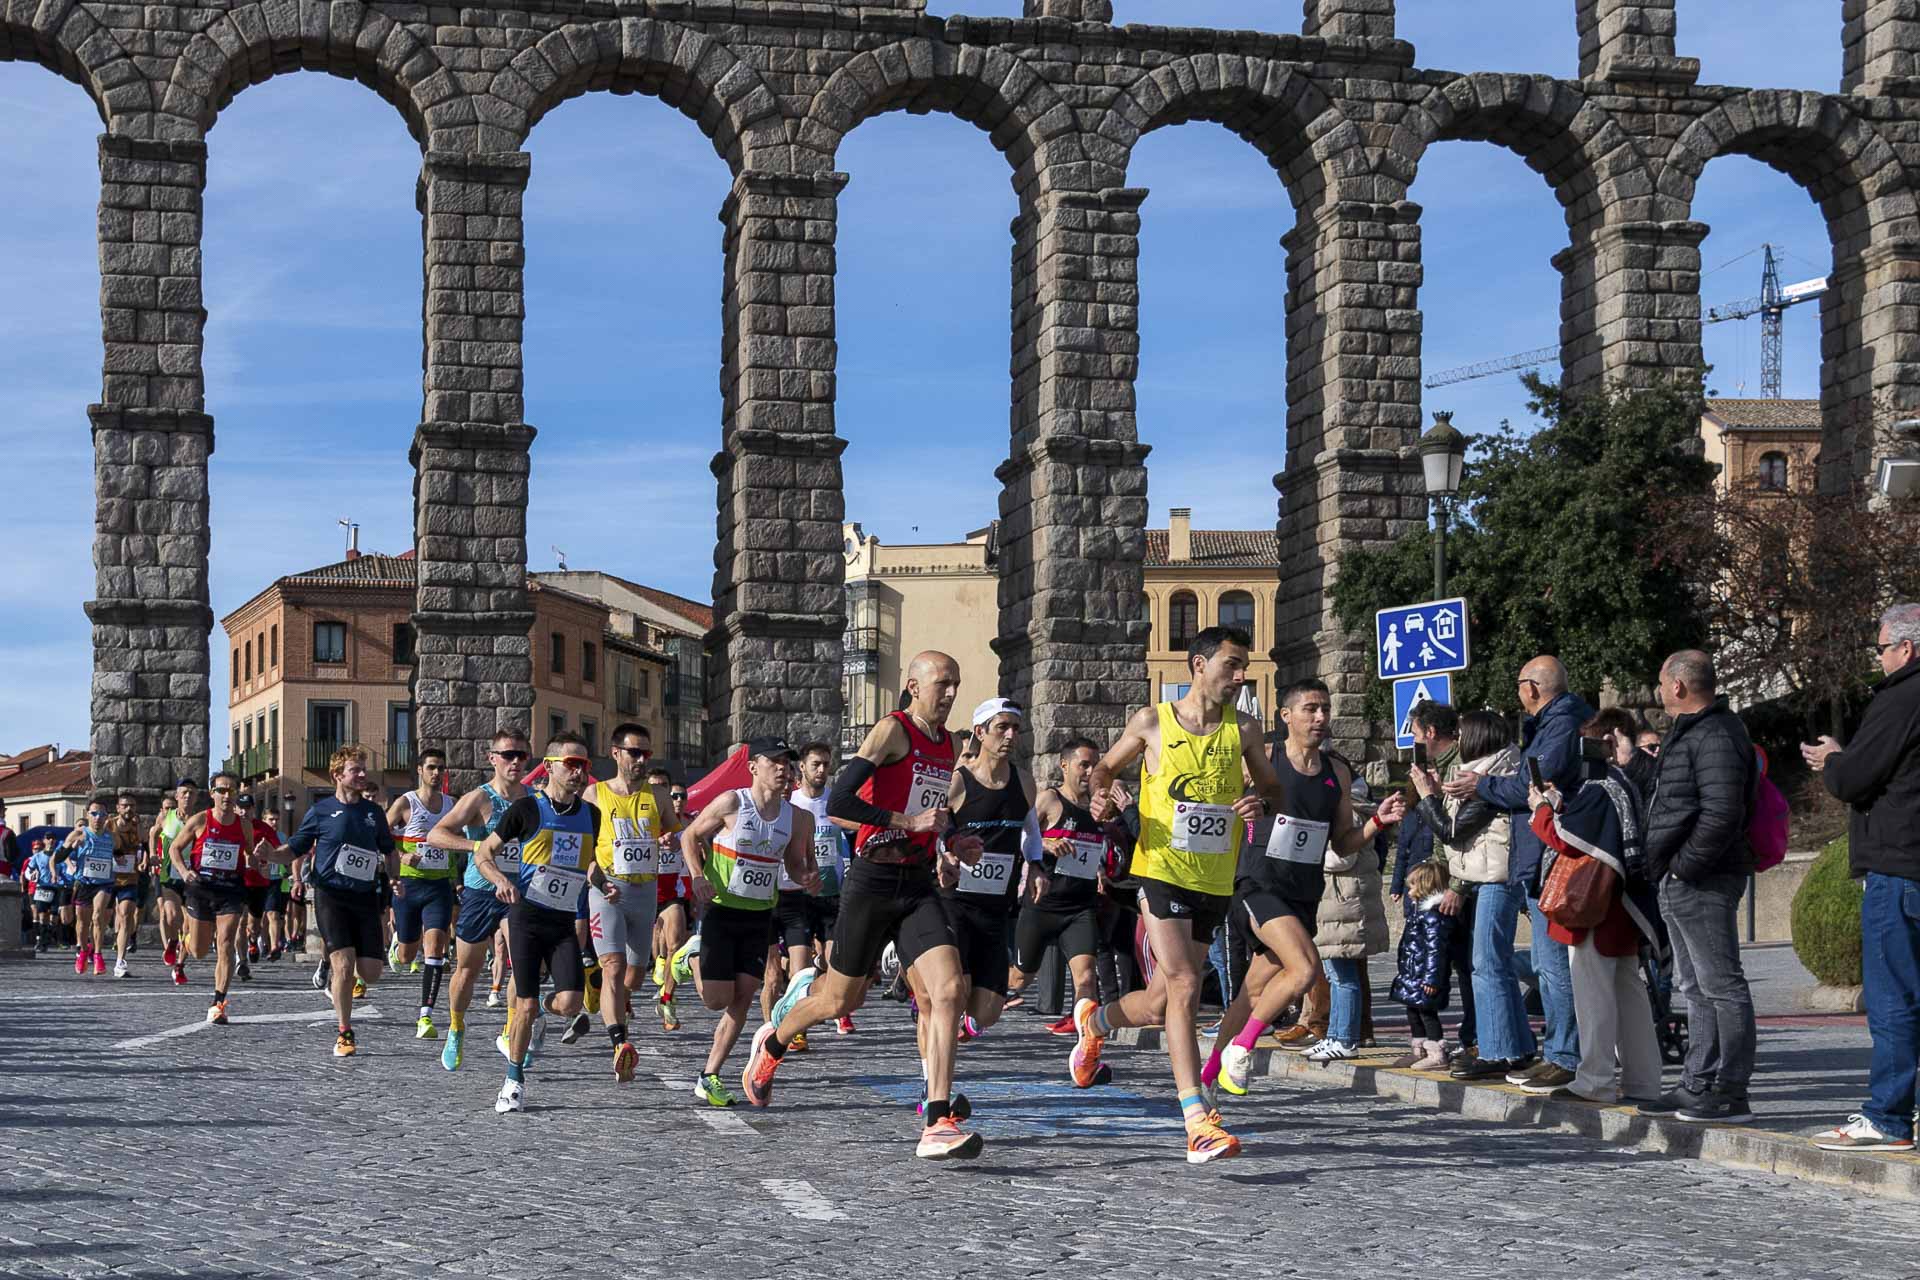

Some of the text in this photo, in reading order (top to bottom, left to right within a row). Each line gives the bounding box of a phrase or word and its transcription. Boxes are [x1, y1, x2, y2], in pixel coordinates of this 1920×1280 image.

[1188, 815, 1227, 836] 923
[1295, 830, 1308, 847] 9
[209, 849, 232, 861] 479
[346, 854, 370, 870] 961
[624, 848, 651, 861] 604
[1078, 851, 1088, 865] 4
[90, 863, 107, 872] 937
[972, 863, 1005, 880] 802
[743, 870, 773, 887] 680
[548, 879, 569, 897] 61
